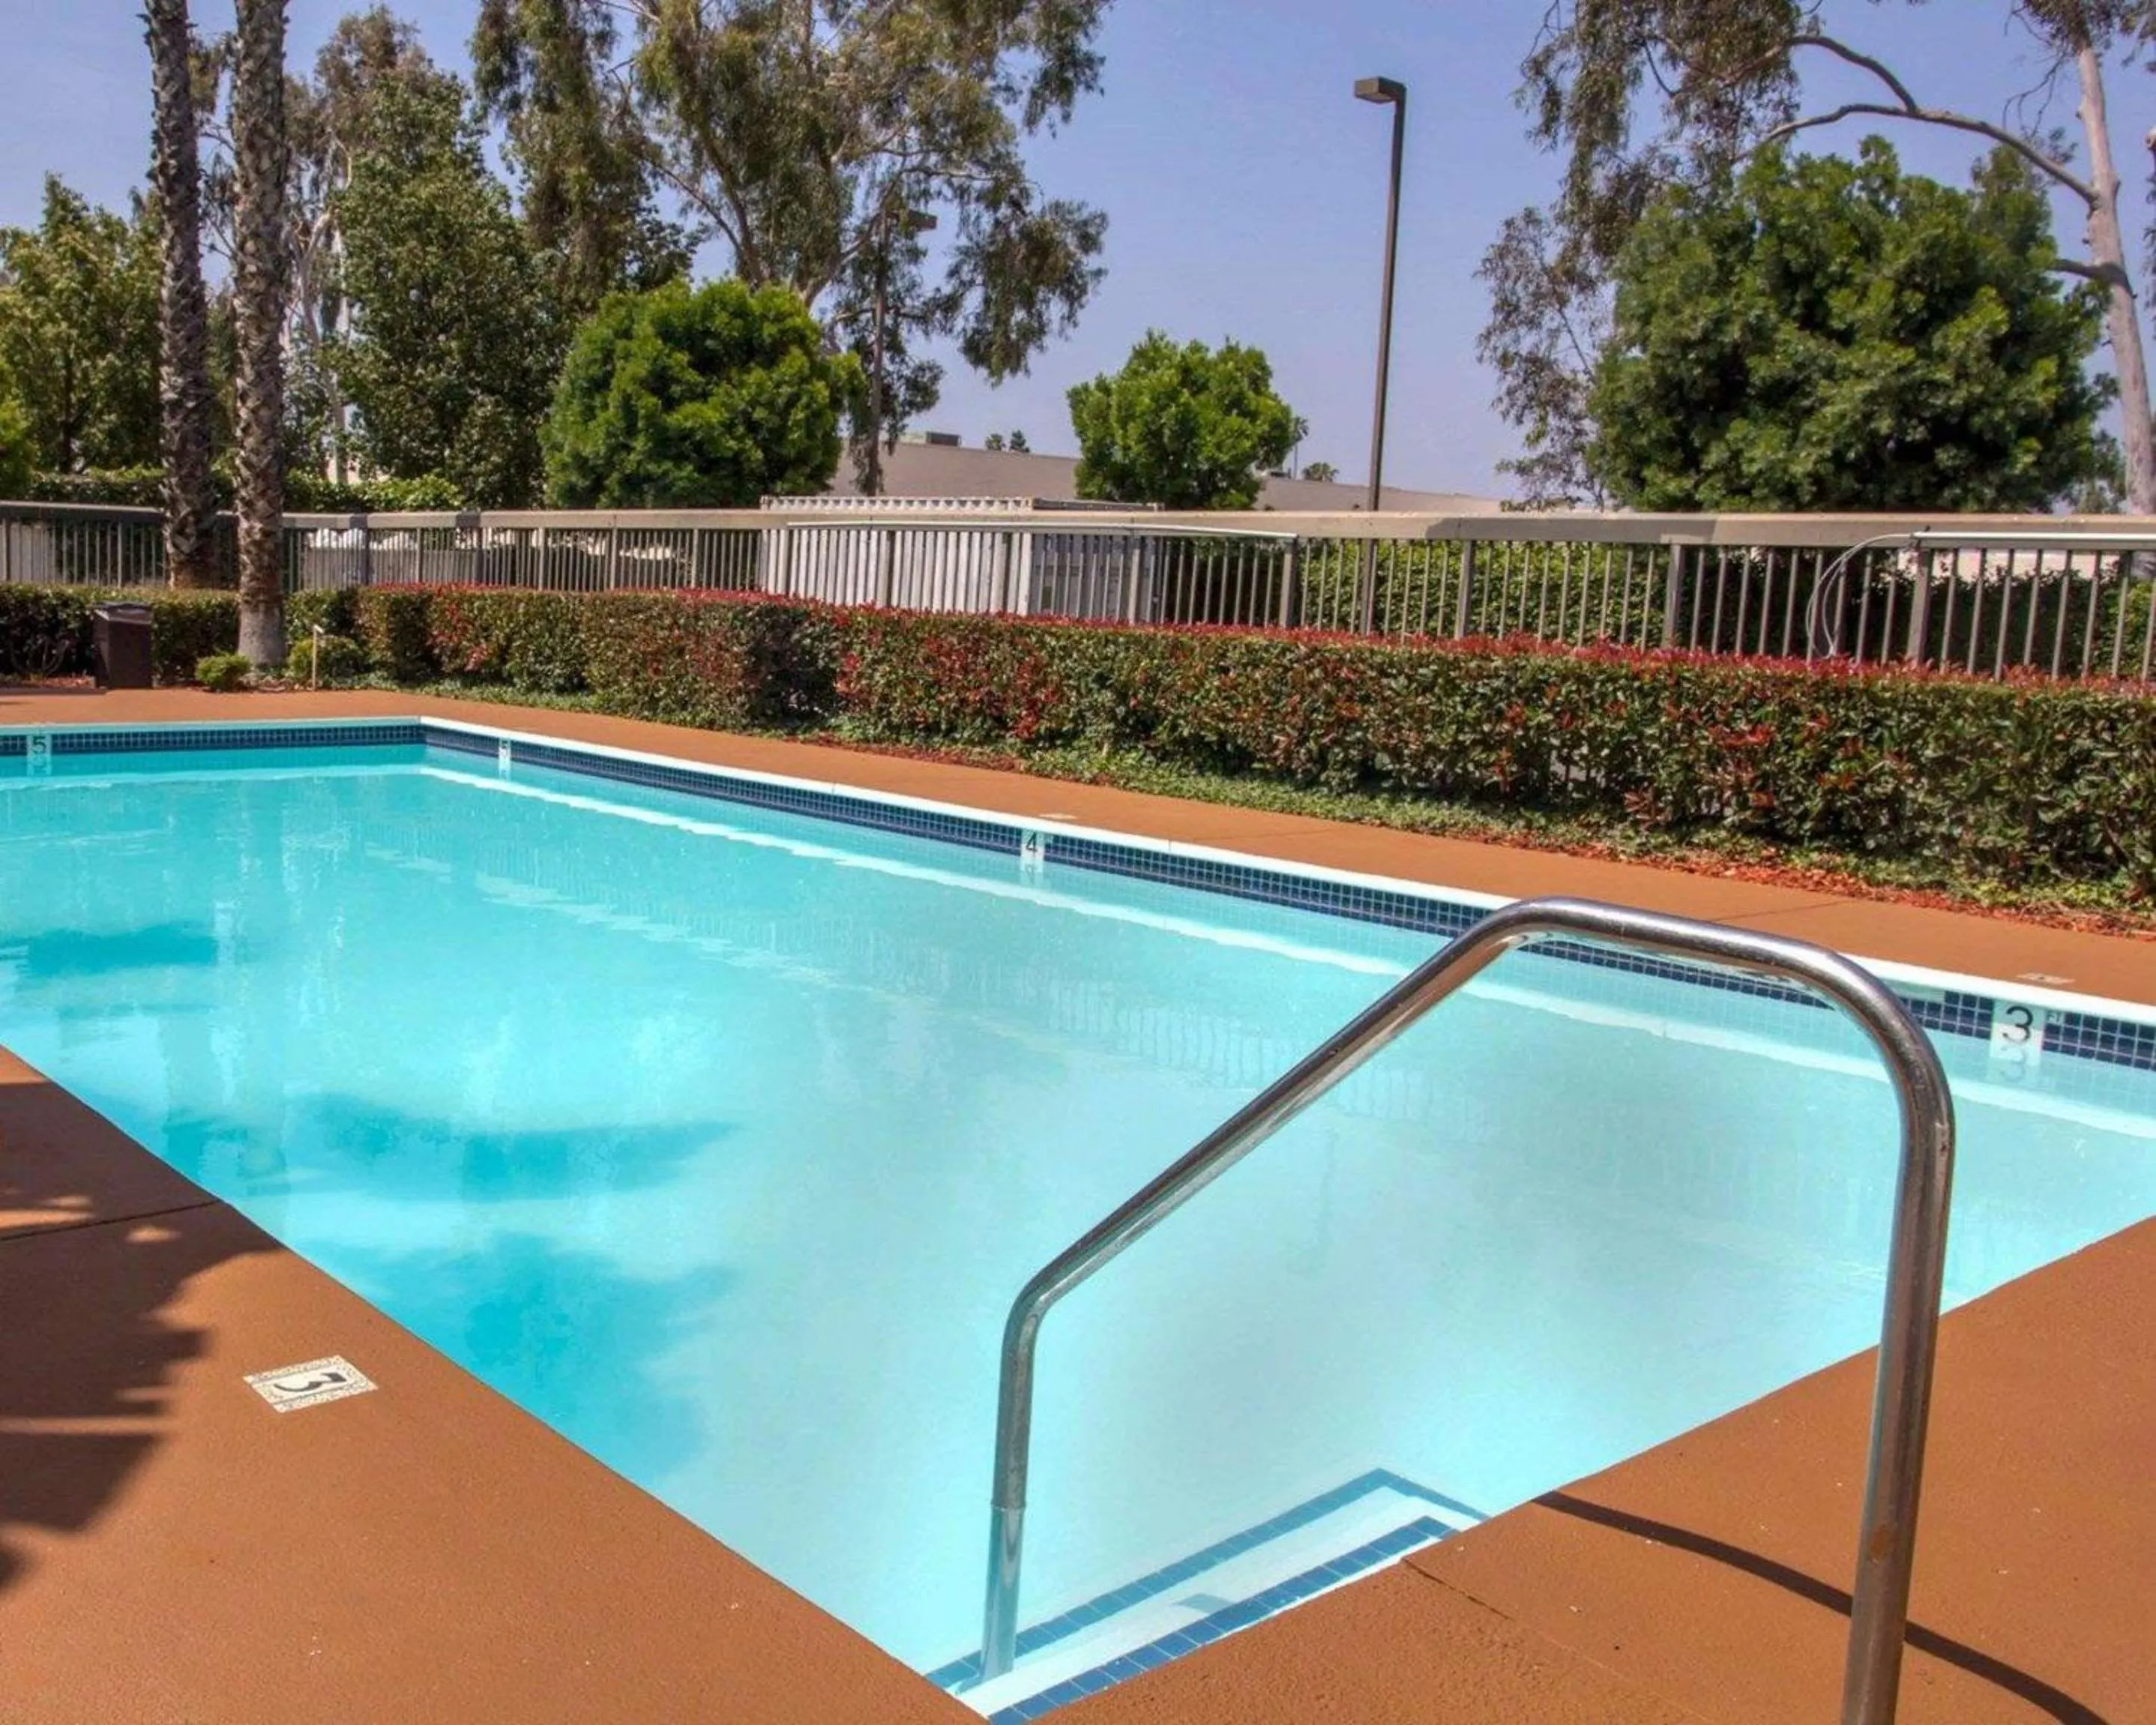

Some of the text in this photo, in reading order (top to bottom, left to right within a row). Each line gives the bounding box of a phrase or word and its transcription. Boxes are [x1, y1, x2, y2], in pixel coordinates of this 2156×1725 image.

[1025, 832, 1038, 857] 4
[2003, 1006, 2034, 1043] 3
[273, 1372, 347, 1392] 3
